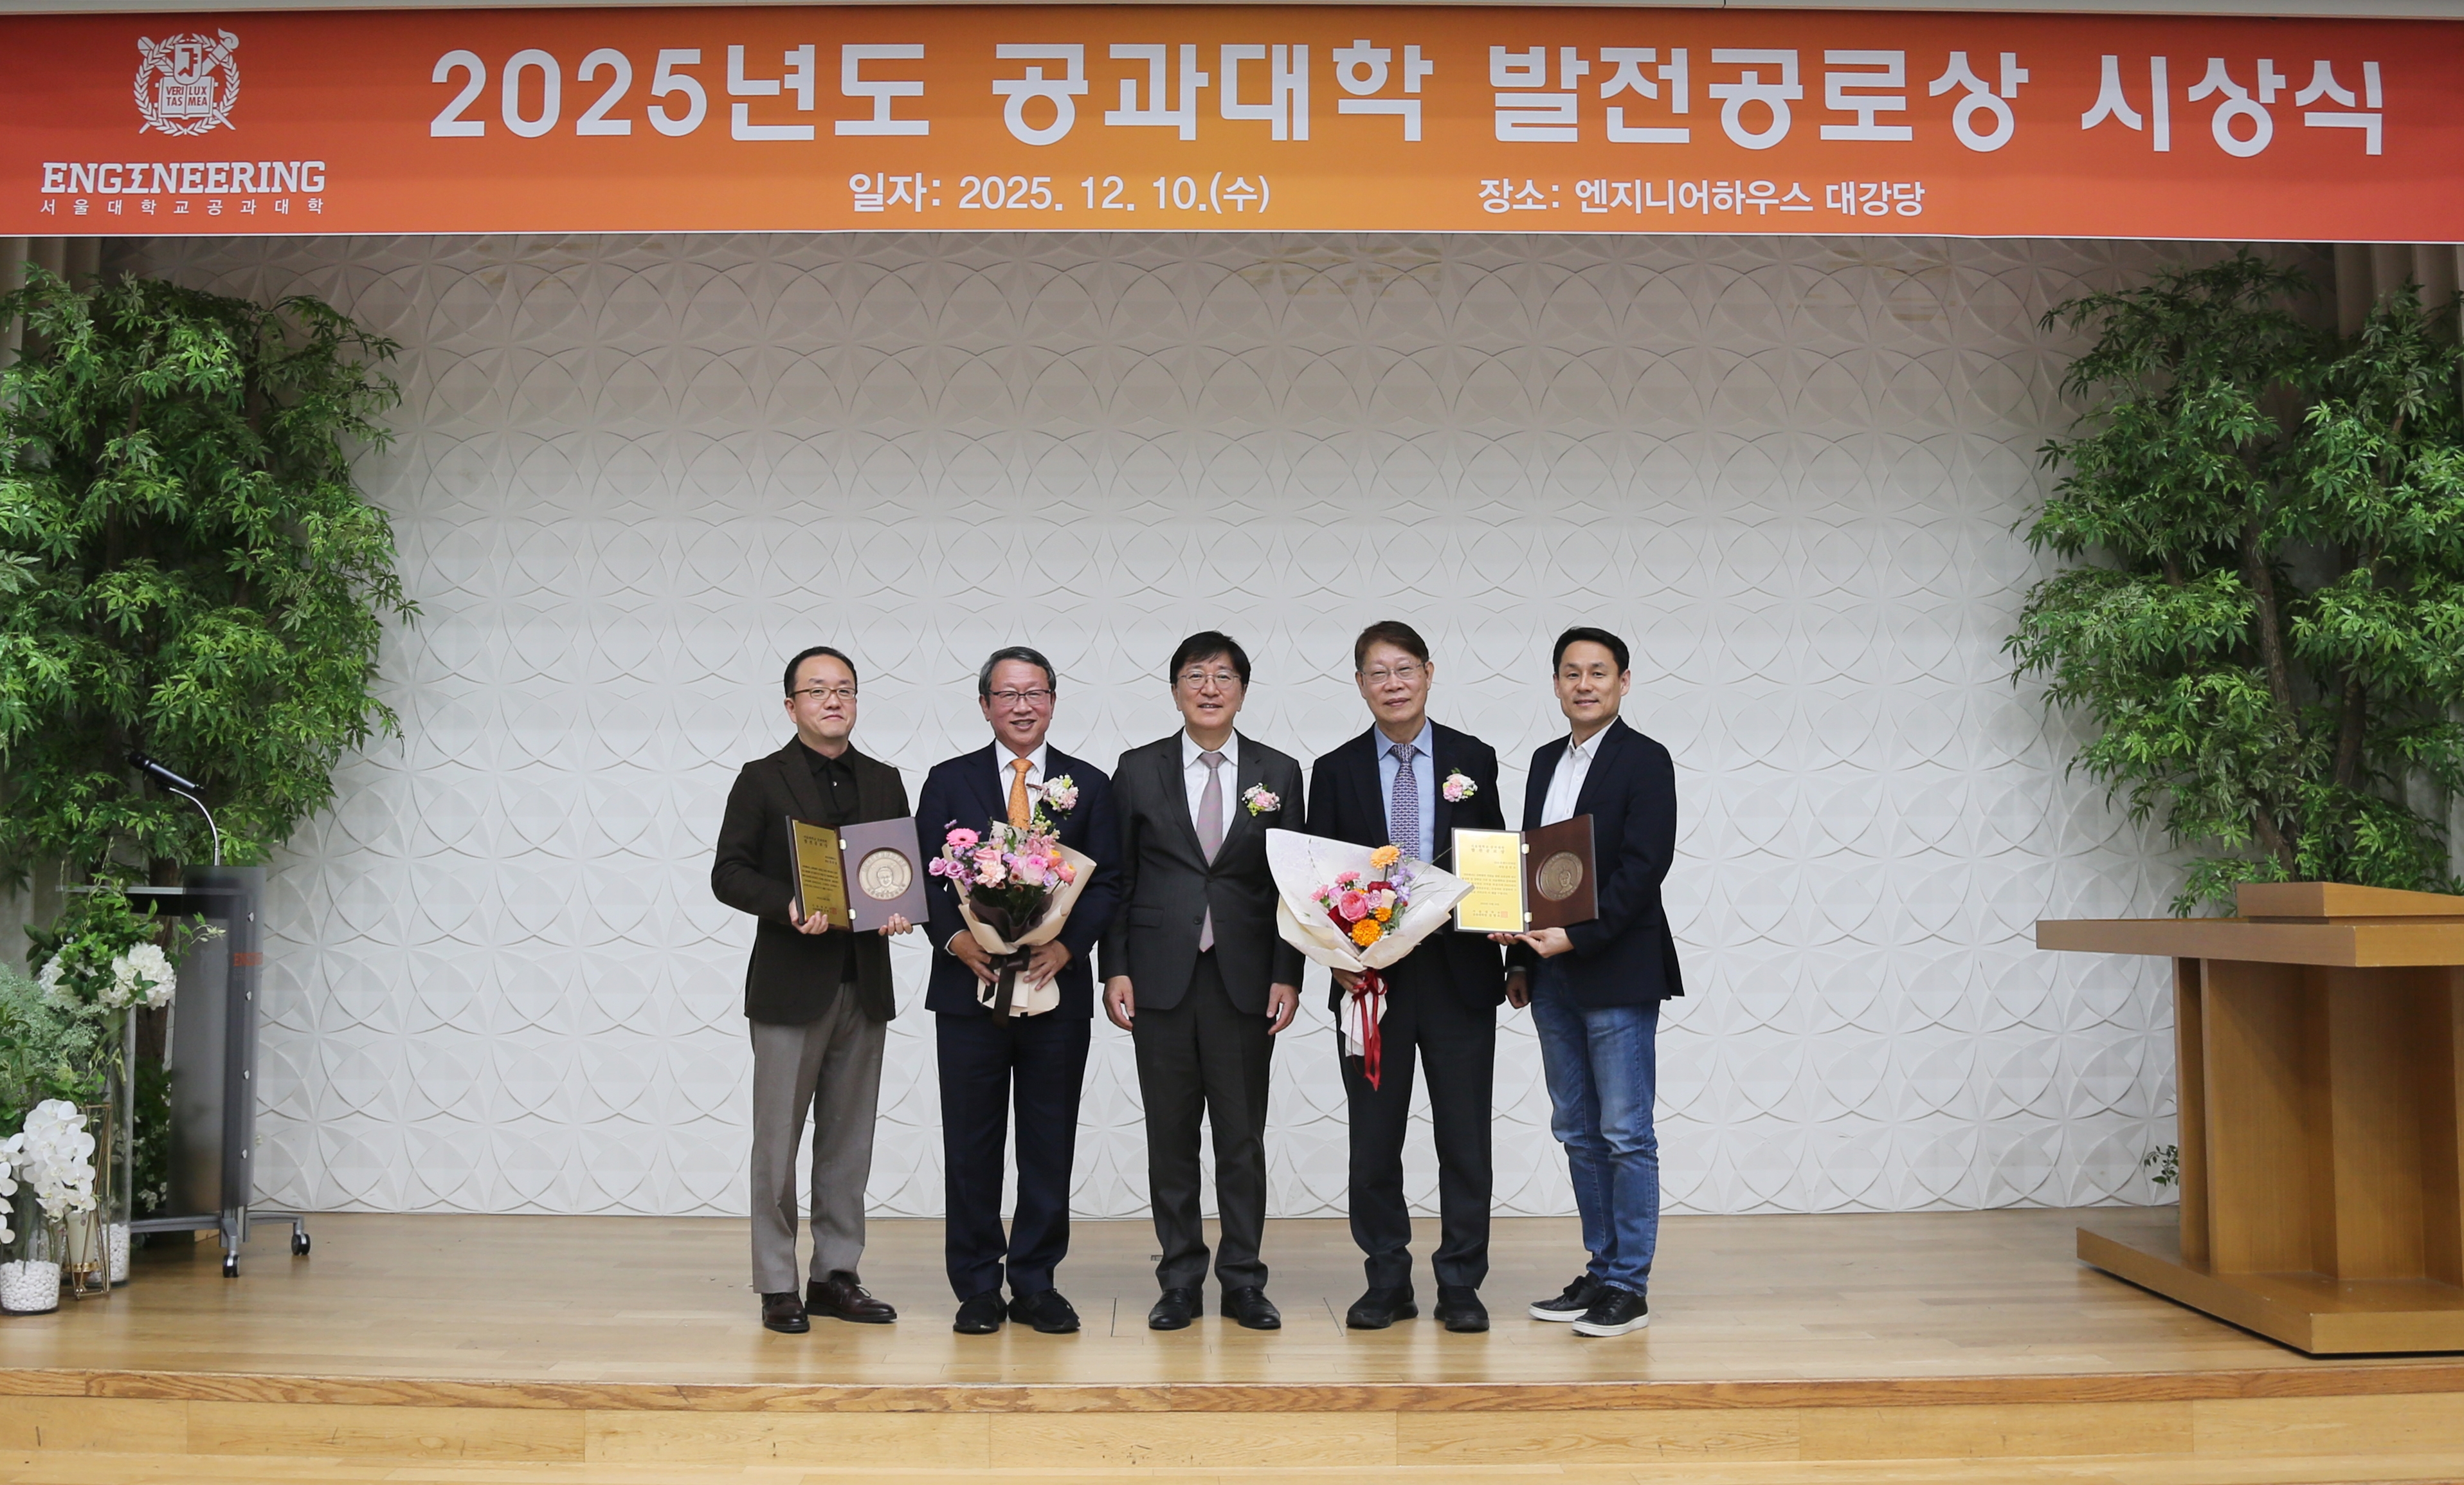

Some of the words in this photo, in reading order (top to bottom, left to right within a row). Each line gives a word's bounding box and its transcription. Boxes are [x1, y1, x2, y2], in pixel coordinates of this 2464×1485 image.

[166, 86, 184, 95] VERI
[189, 86, 207, 95] LUX
[430, 44, 930, 141] 2025년도
[992, 39, 1433, 146] 공과대학
[1489, 46, 2029, 152] 발전공로상
[2081, 55, 2382, 158] 시상식
[167, 96, 183, 106] TAS
[188, 96, 208, 106] MEA
[41, 161, 325, 194] ENGINEERING
[849, 172, 941, 212] 일자:
[958, 176, 1064, 211] 2025.
[1081, 176, 1135, 212] 12.
[1152, 171, 1270, 214] 10.(수)
[1478, 178, 1559, 214] 장소:
[1575, 179, 1814, 215] 엔지니어하우스
[1825, 181, 1926, 217] 대강당
[40, 197, 323, 215] 서울대학교공과대학
